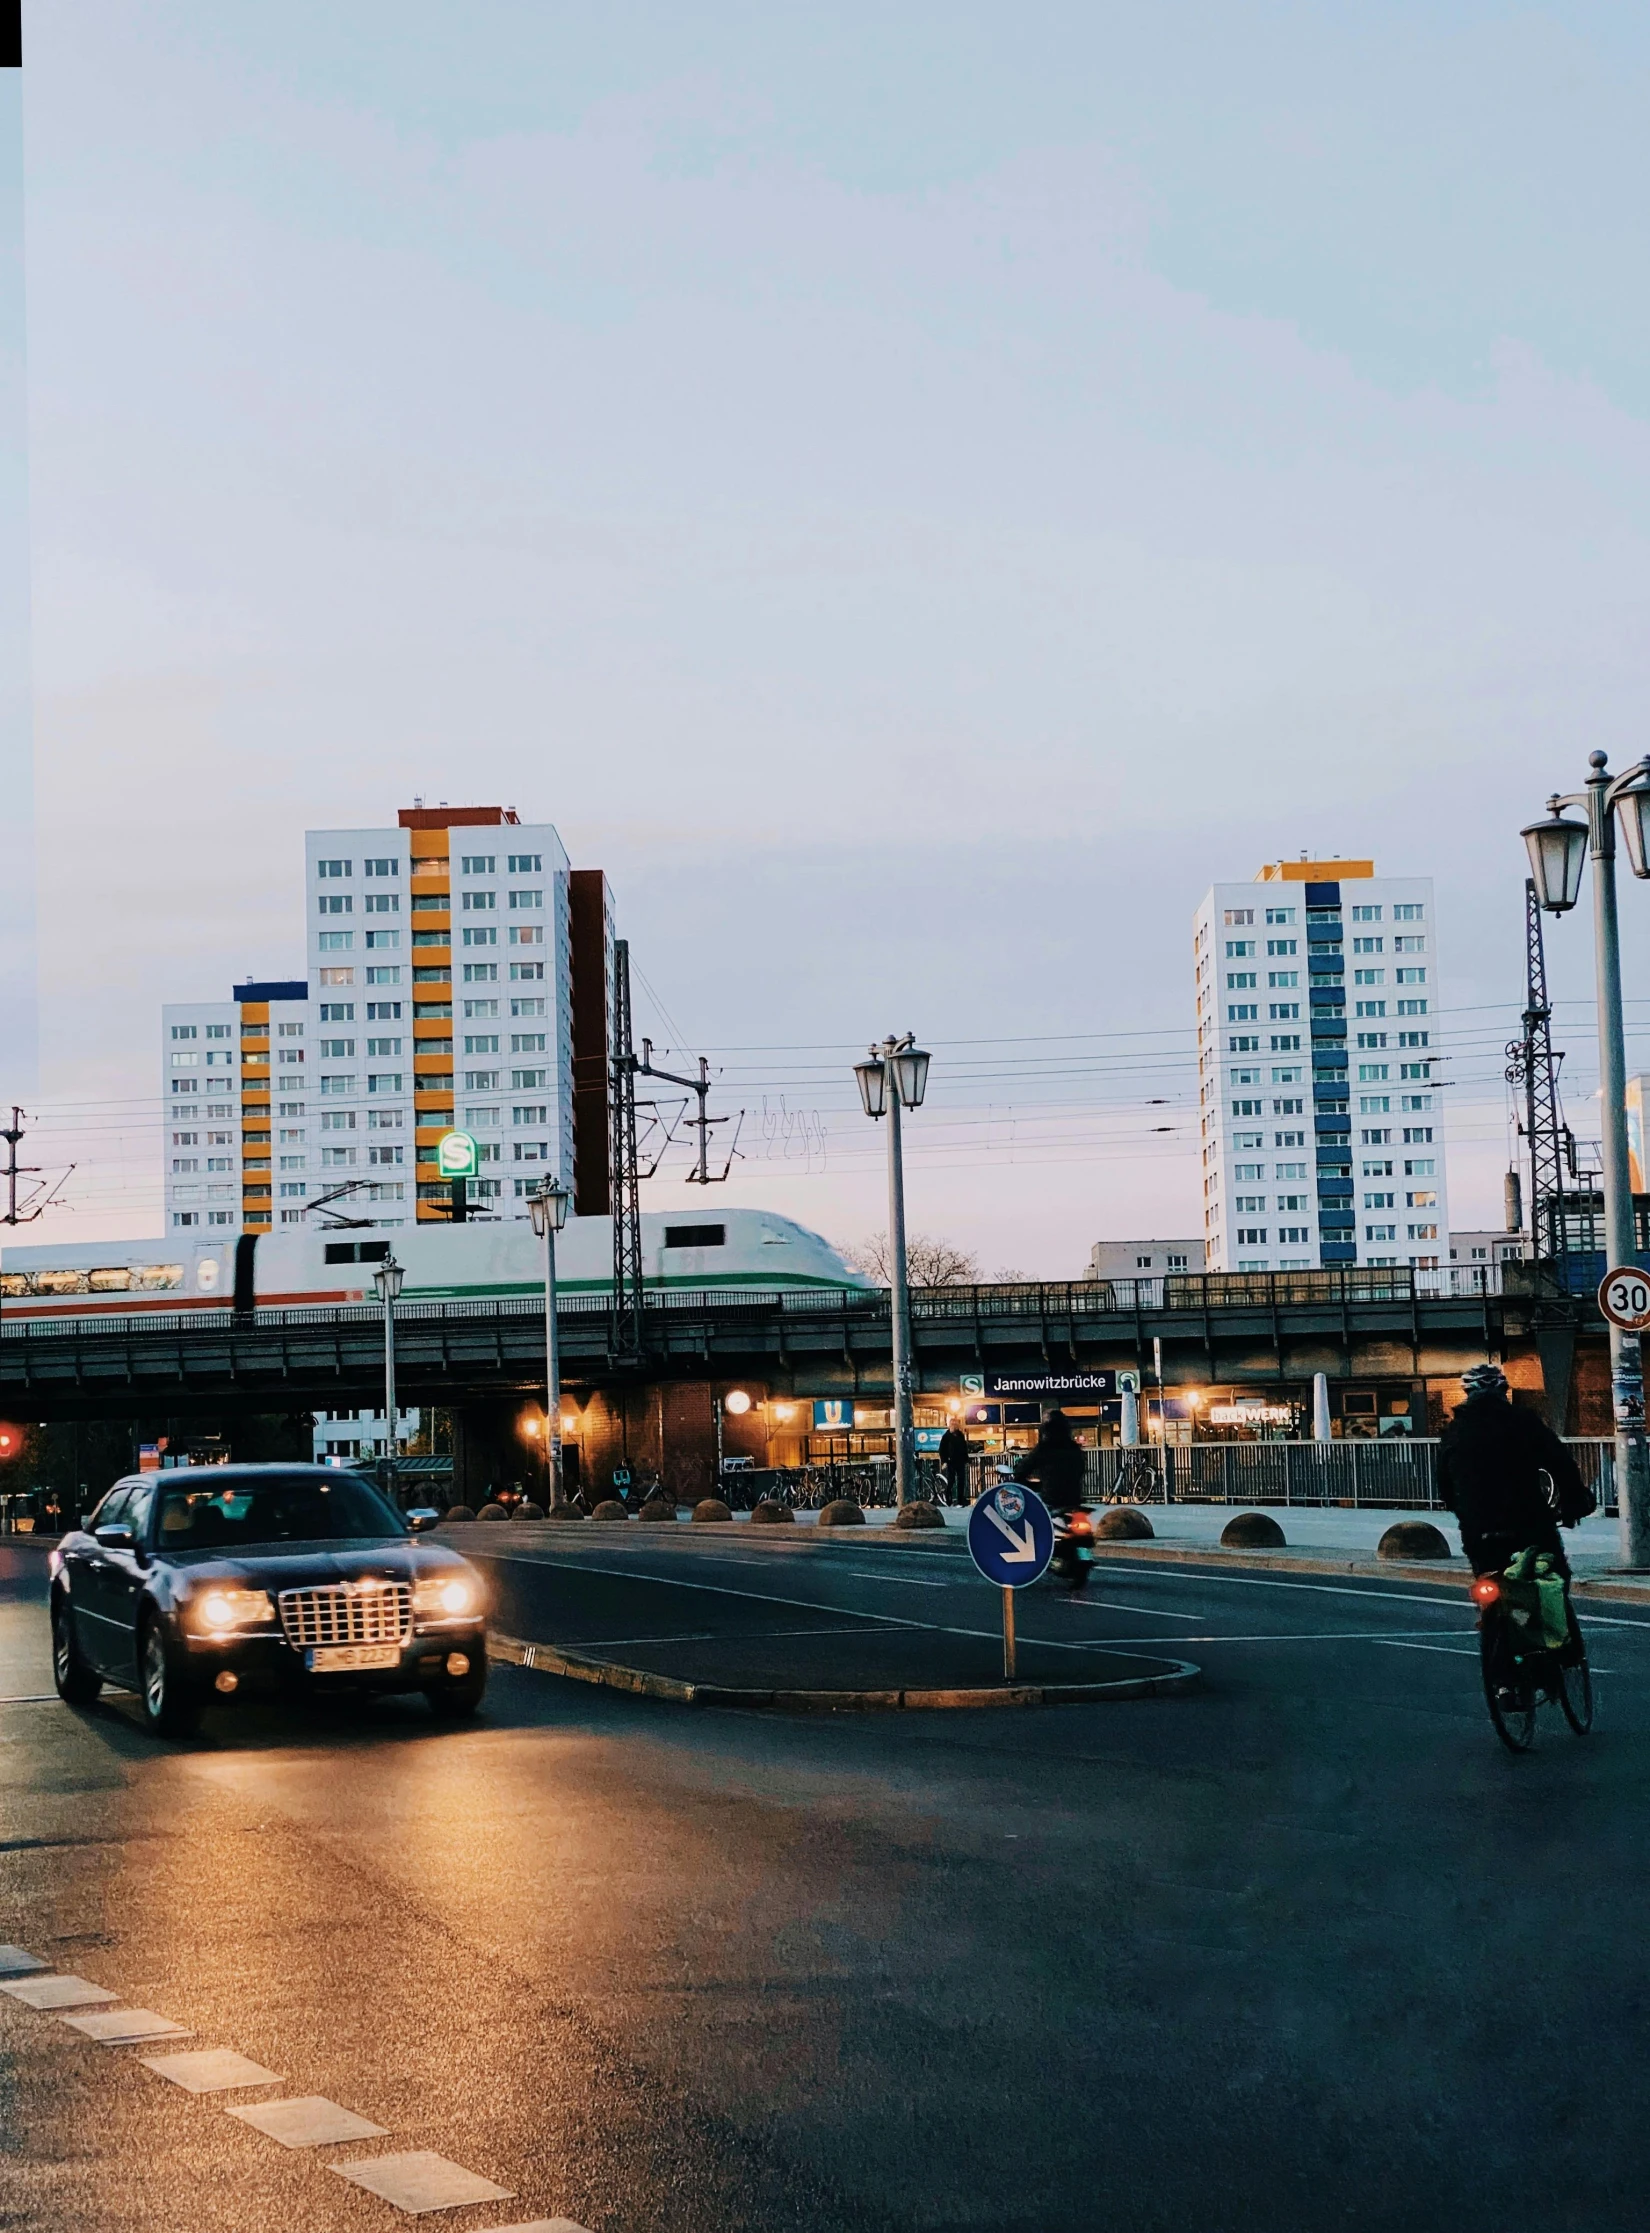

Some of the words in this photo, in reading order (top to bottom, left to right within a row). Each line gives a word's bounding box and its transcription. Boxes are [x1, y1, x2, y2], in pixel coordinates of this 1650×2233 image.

[443, 1135, 471, 1169] S
[1612, 1283, 1647, 1312] 30
[964, 1377, 981, 1395] S
[994, 1374, 1106, 1391] Jannowitzbrücke
[824, 1400, 842, 1423] U
